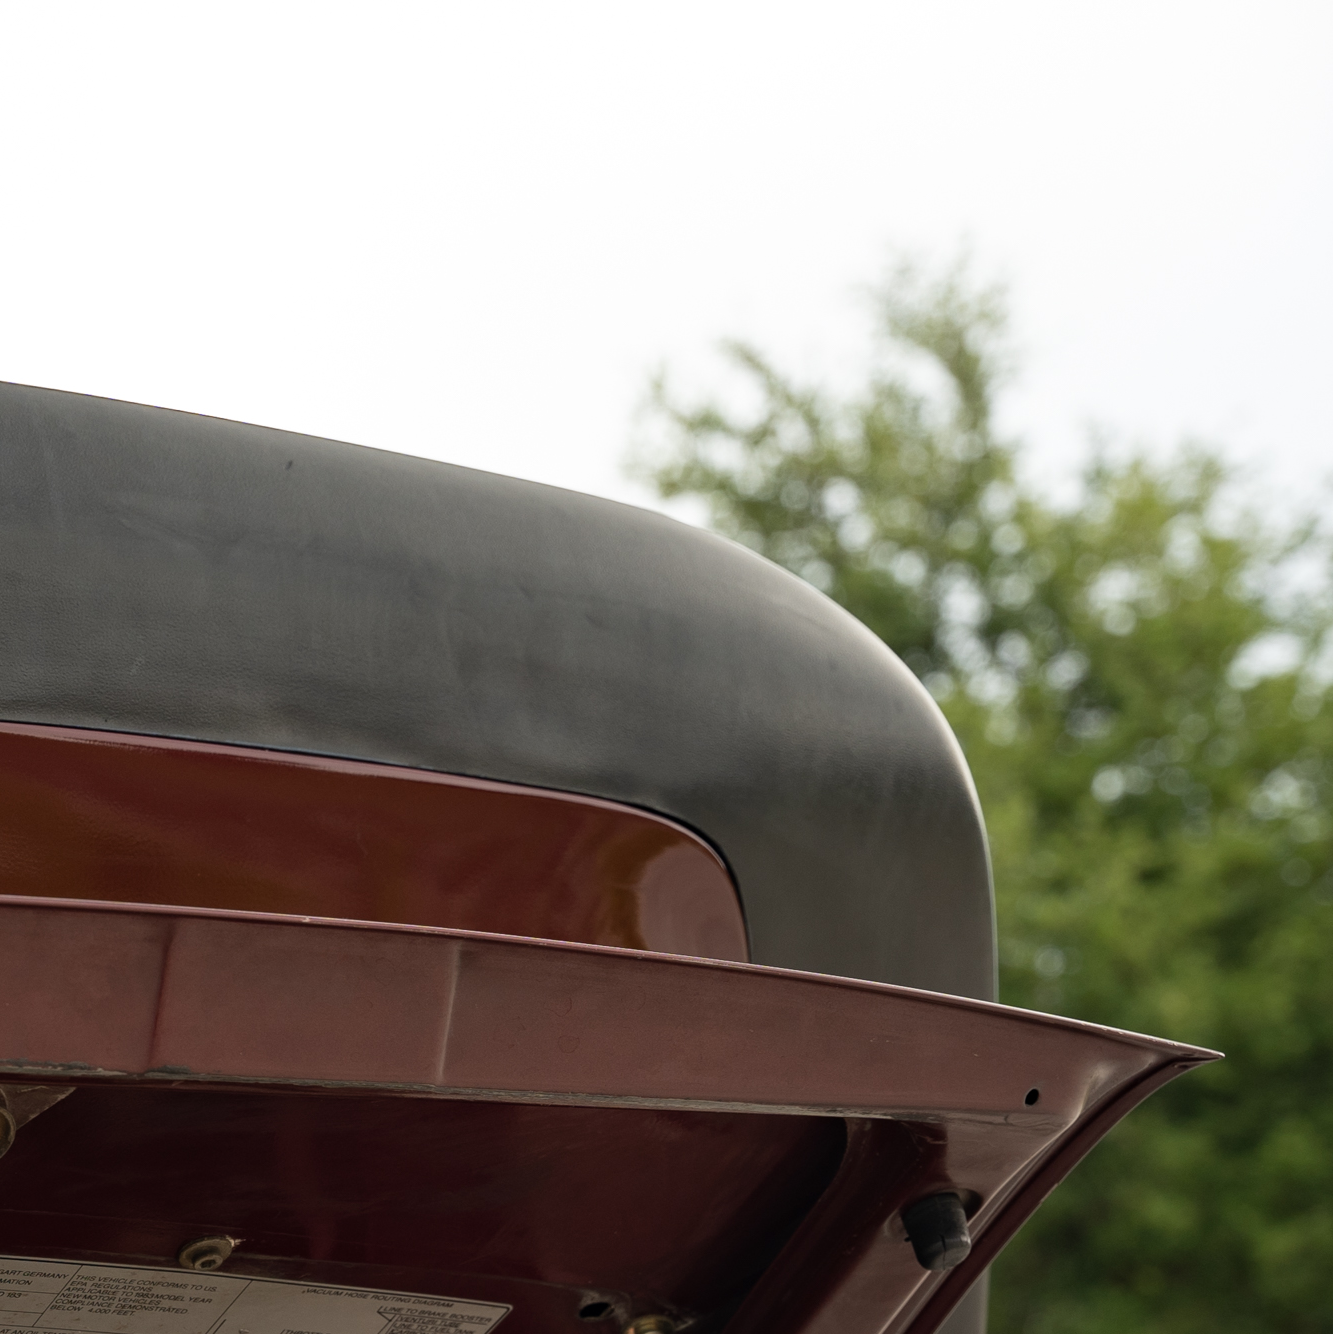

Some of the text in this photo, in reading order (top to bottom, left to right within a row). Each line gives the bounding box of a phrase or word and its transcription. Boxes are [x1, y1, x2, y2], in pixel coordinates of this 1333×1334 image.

[21, 1271, 69, 1279] GERMANY
[89, 1282, 154, 1292] REGULATIONS
[96, 1276, 136, 1284] VEHICLE
[135, 1280, 189, 1289] CONFORMS
[63, 1286, 119, 1295] APPLICABLE
[152, 1293, 187, 1301] MODEL
[303, 1288, 343, 1296] VACUUM
[369, 1295, 412, 1303] ROUTING
[411, 1299, 455, 1307] DIAGRAM
[54, 1298, 189, 1314] COMPLIANCE DEMONSTRATED
